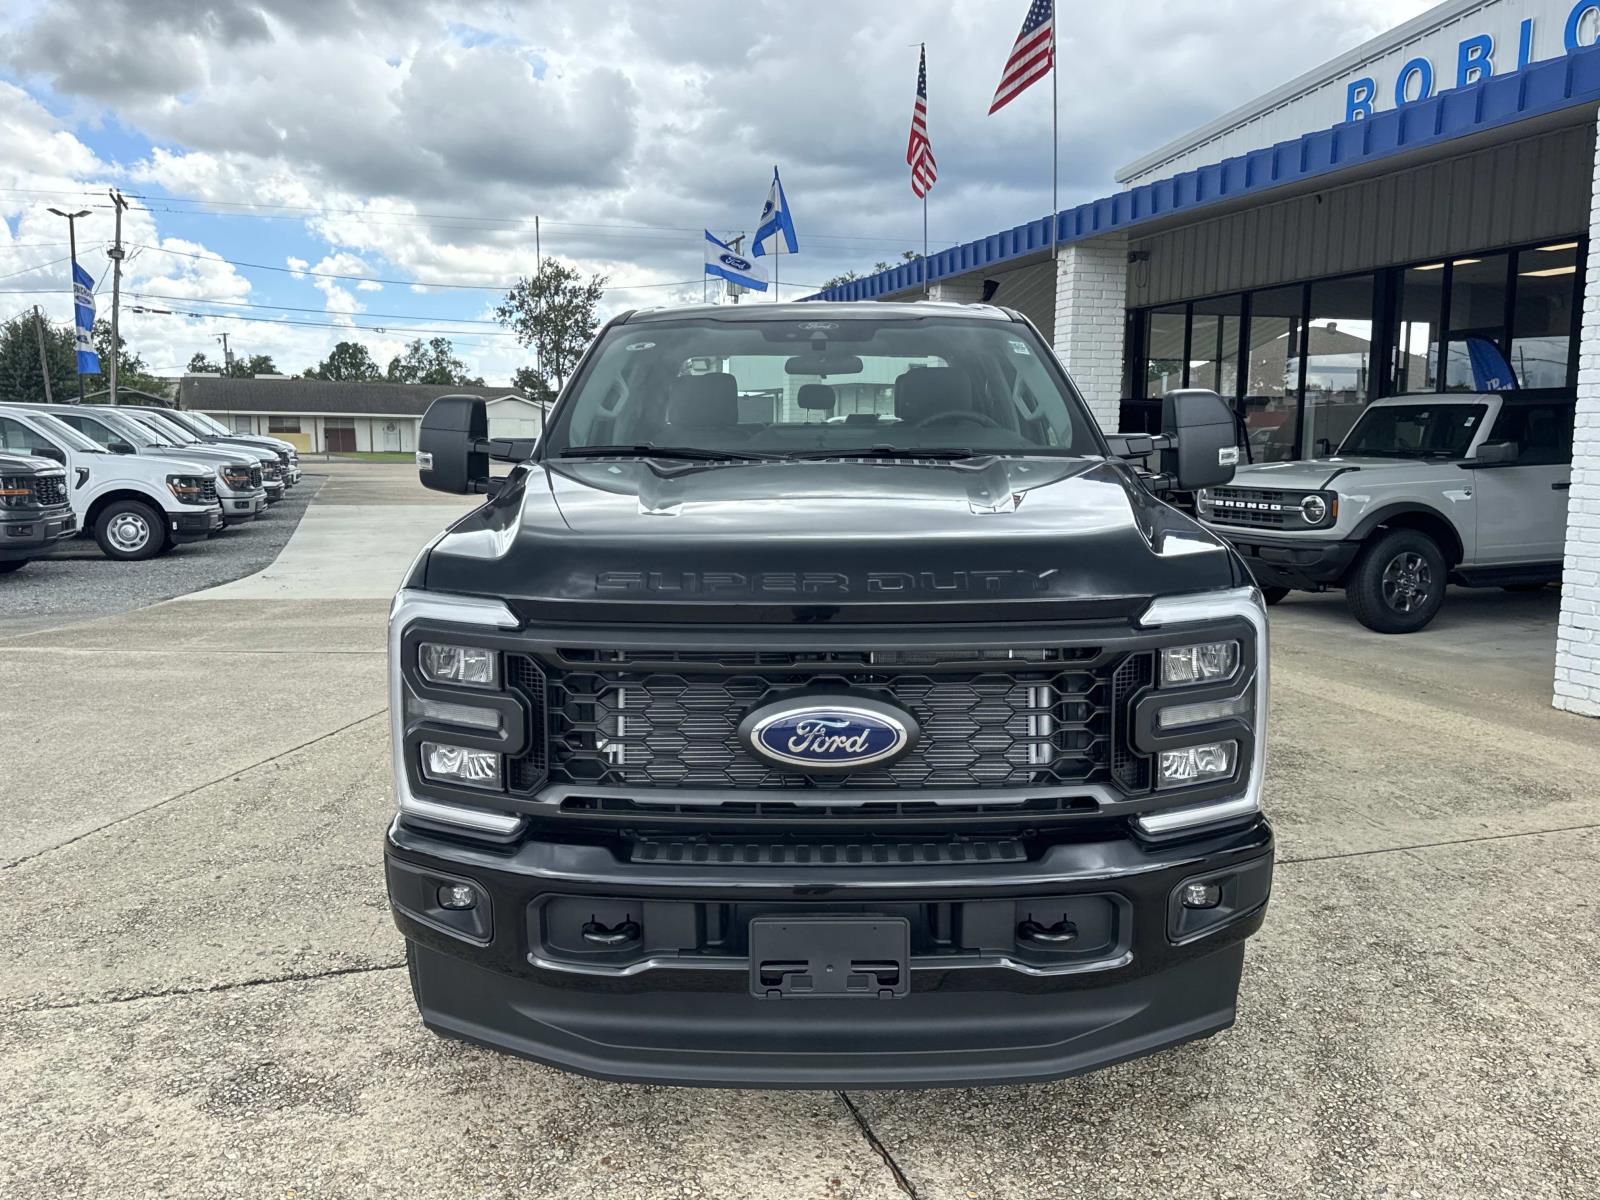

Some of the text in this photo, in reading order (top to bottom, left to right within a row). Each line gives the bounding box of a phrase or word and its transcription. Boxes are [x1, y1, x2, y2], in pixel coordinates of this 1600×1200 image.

[725, 256, 746, 270] Ford
[1215, 500, 1281, 511] BRONCO
[595, 569, 1060, 592] SUPER DUTY
[788, 719, 871, 753] Ford
